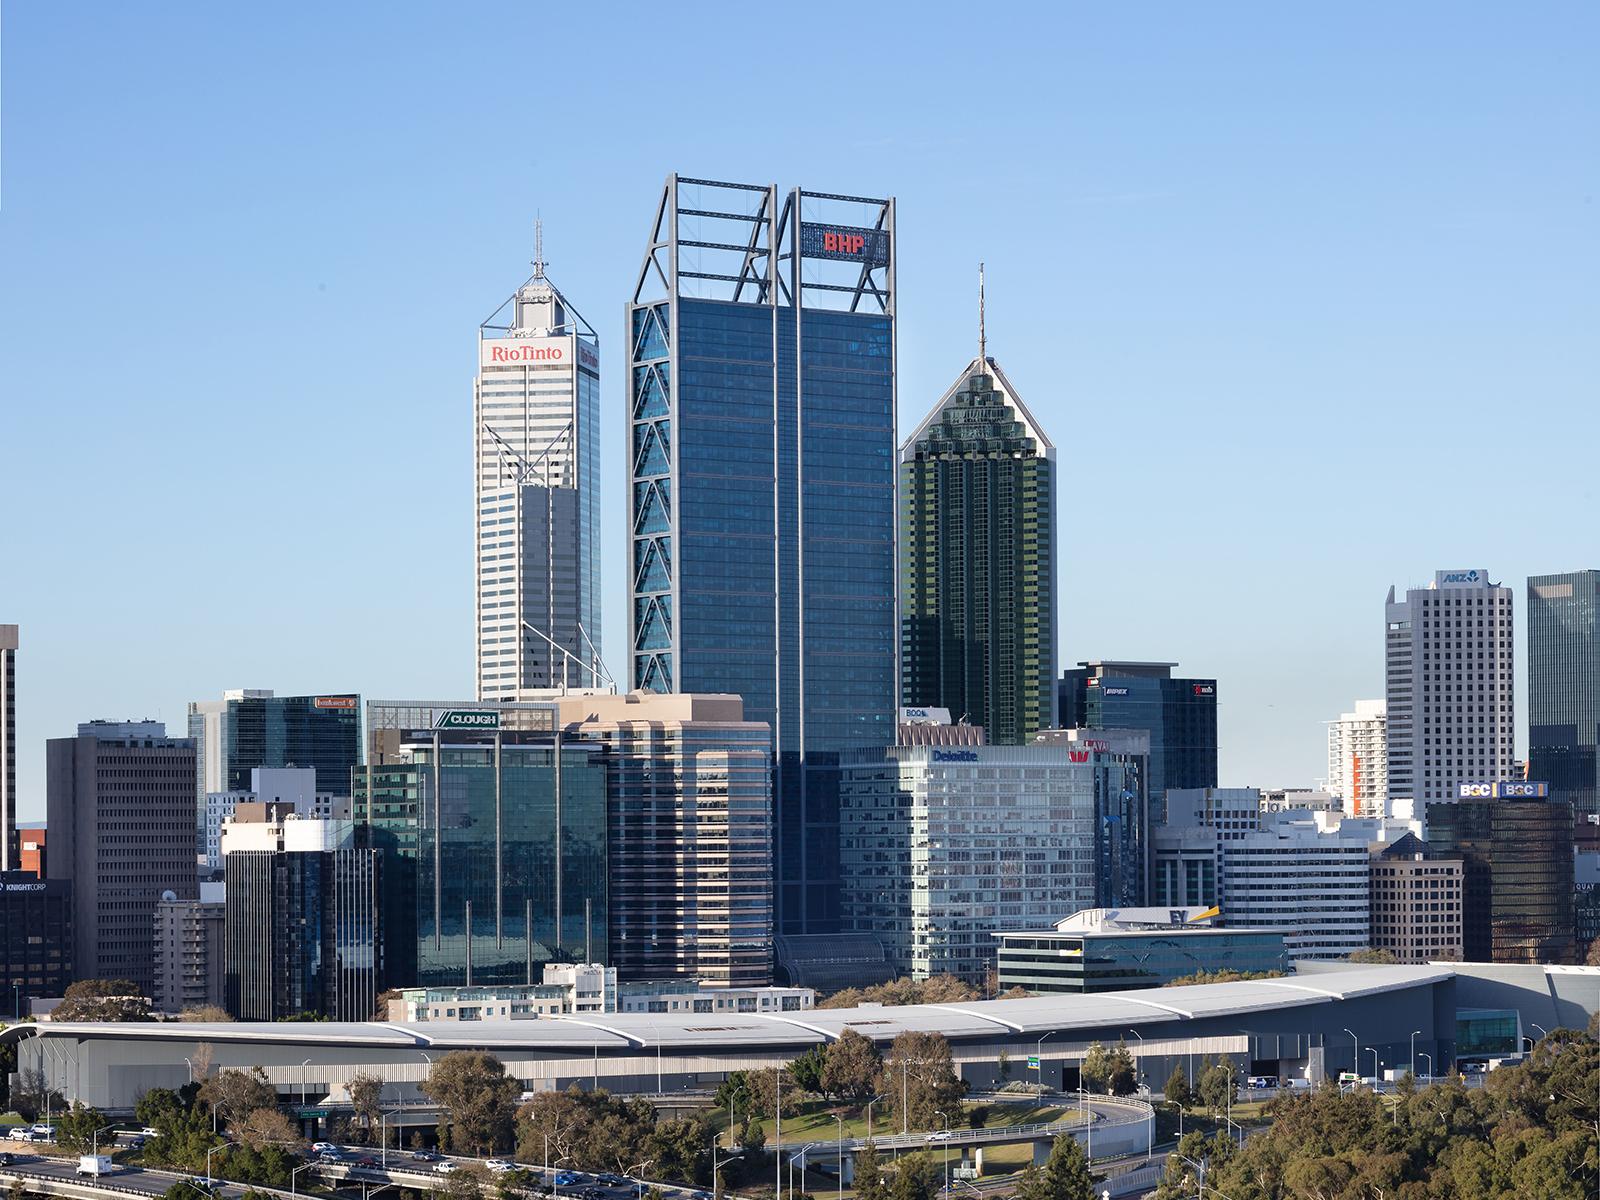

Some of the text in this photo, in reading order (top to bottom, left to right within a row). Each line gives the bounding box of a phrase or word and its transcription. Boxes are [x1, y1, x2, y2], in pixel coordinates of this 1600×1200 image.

[824, 232, 865, 254] BHP
[1443, 573, 1467, 583] ANZ
[450, 714, 497, 724] CLOUGH
[932, 749, 979, 762] Deloitte
[1460, 783, 1491, 797] BGC
[1506, 784, 1534, 796] BGC
[6, 883, 47, 891] KNIGHTCORP
[1169, 909, 1189, 926] EY
